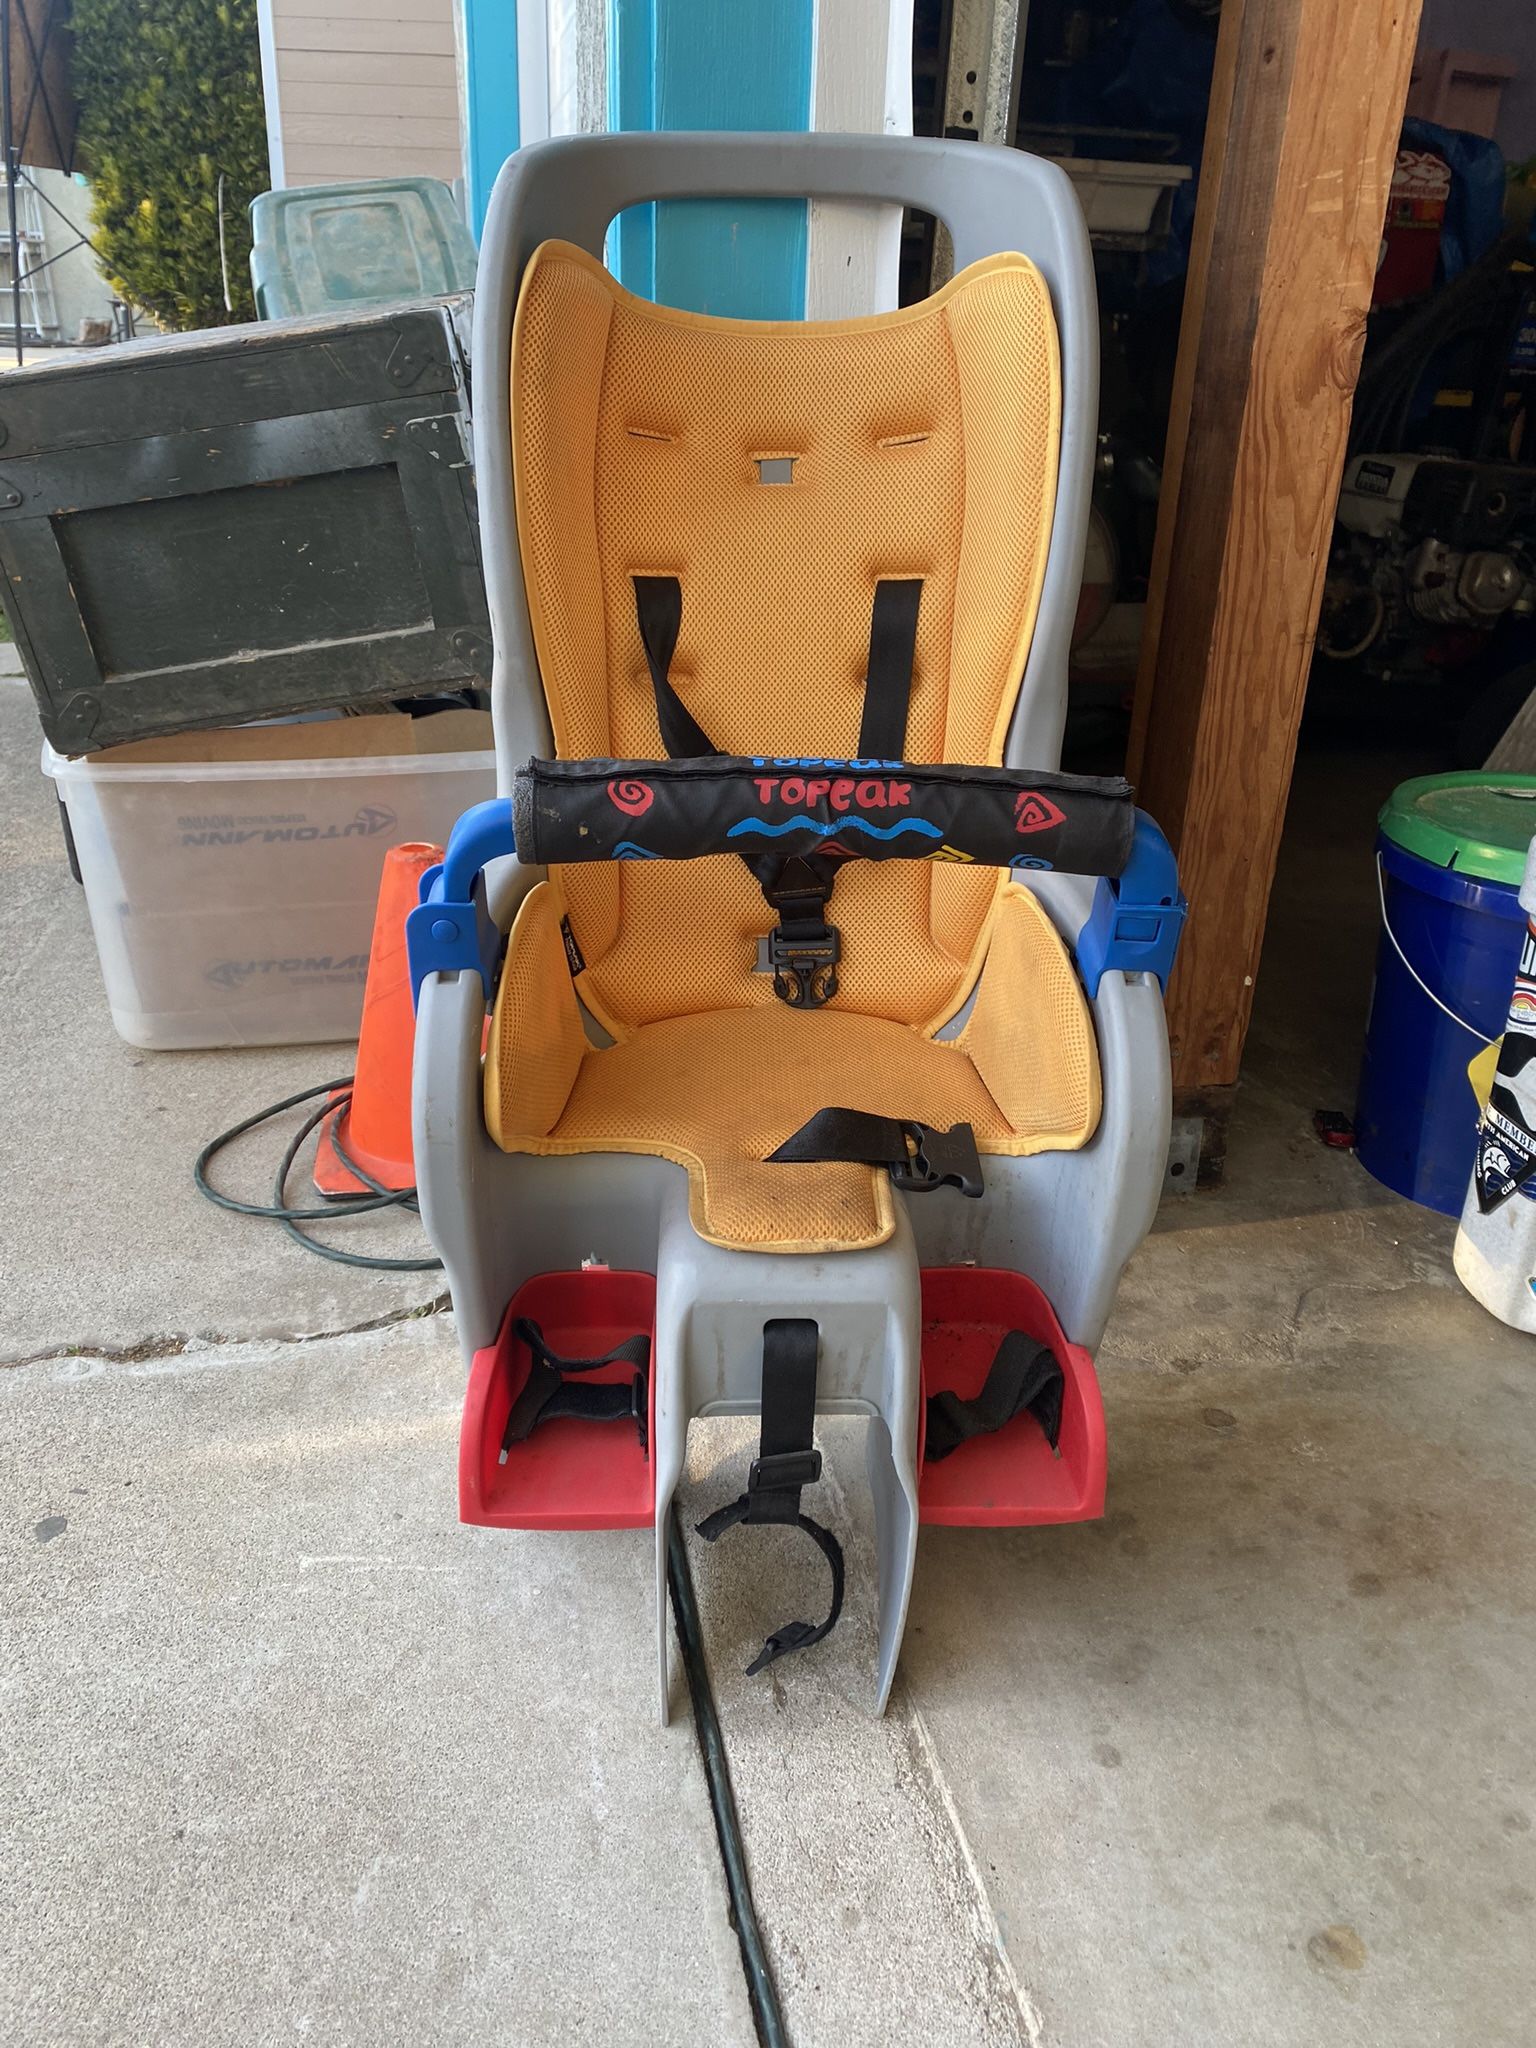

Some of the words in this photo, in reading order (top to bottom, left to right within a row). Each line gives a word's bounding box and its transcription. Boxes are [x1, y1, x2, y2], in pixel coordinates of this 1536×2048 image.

[182, 804, 397, 846] AUTOMANN
[1495, 1114, 1536, 1154] MEMBE
[1496, 1132, 1530, 1161] AMERICAN
[1501, 1178, 1517, 1196] CLUB
